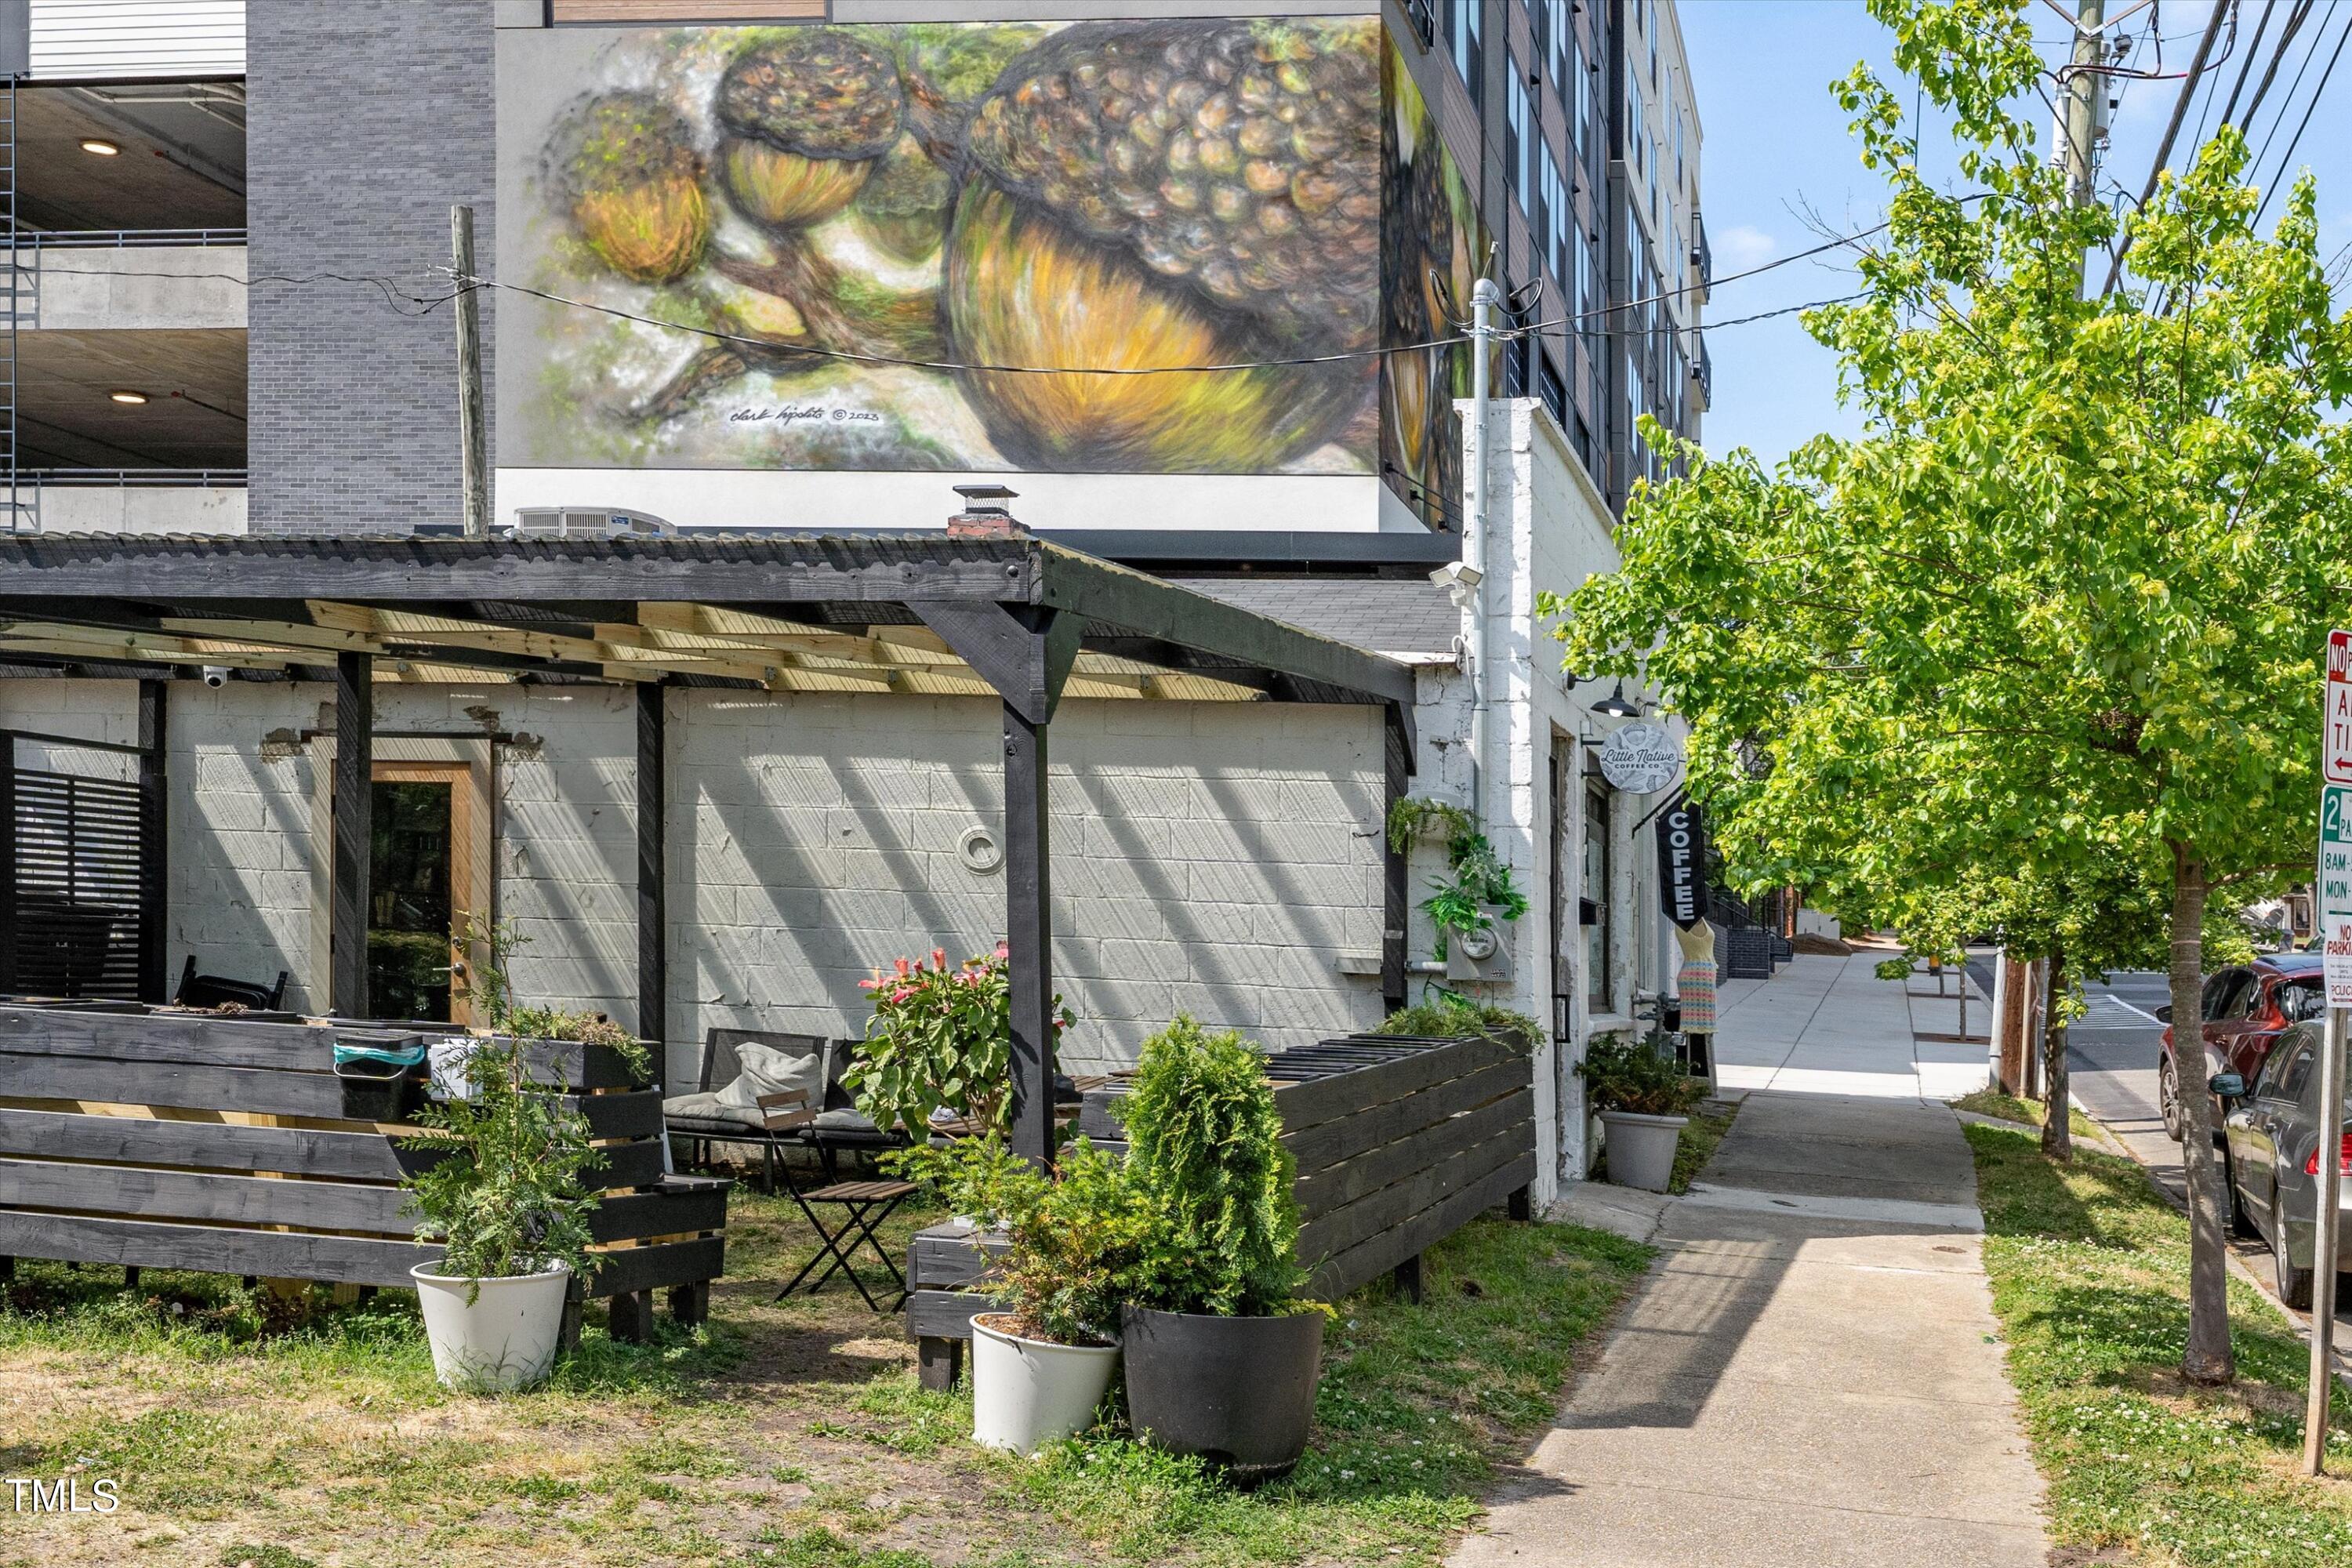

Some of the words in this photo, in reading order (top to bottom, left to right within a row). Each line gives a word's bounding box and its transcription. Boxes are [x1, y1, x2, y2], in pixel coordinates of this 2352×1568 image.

[2329, 644, 2346, 673] NO
[2337, 689, 2352, 717] A
[1601, 749, 1635, 764] Little
[1636, 749, 1675, 764] Native
[2325, 795, 2339, 830] 2
[1668, 811, 1694, 920] COFFEE
[2325, 852, 2352, 872] 8AM-
[2339, 924, 2351, 941] NO
[2327, 940, 2352, 956] PARKI
[2331, 985, 2352, 996] POLIC
